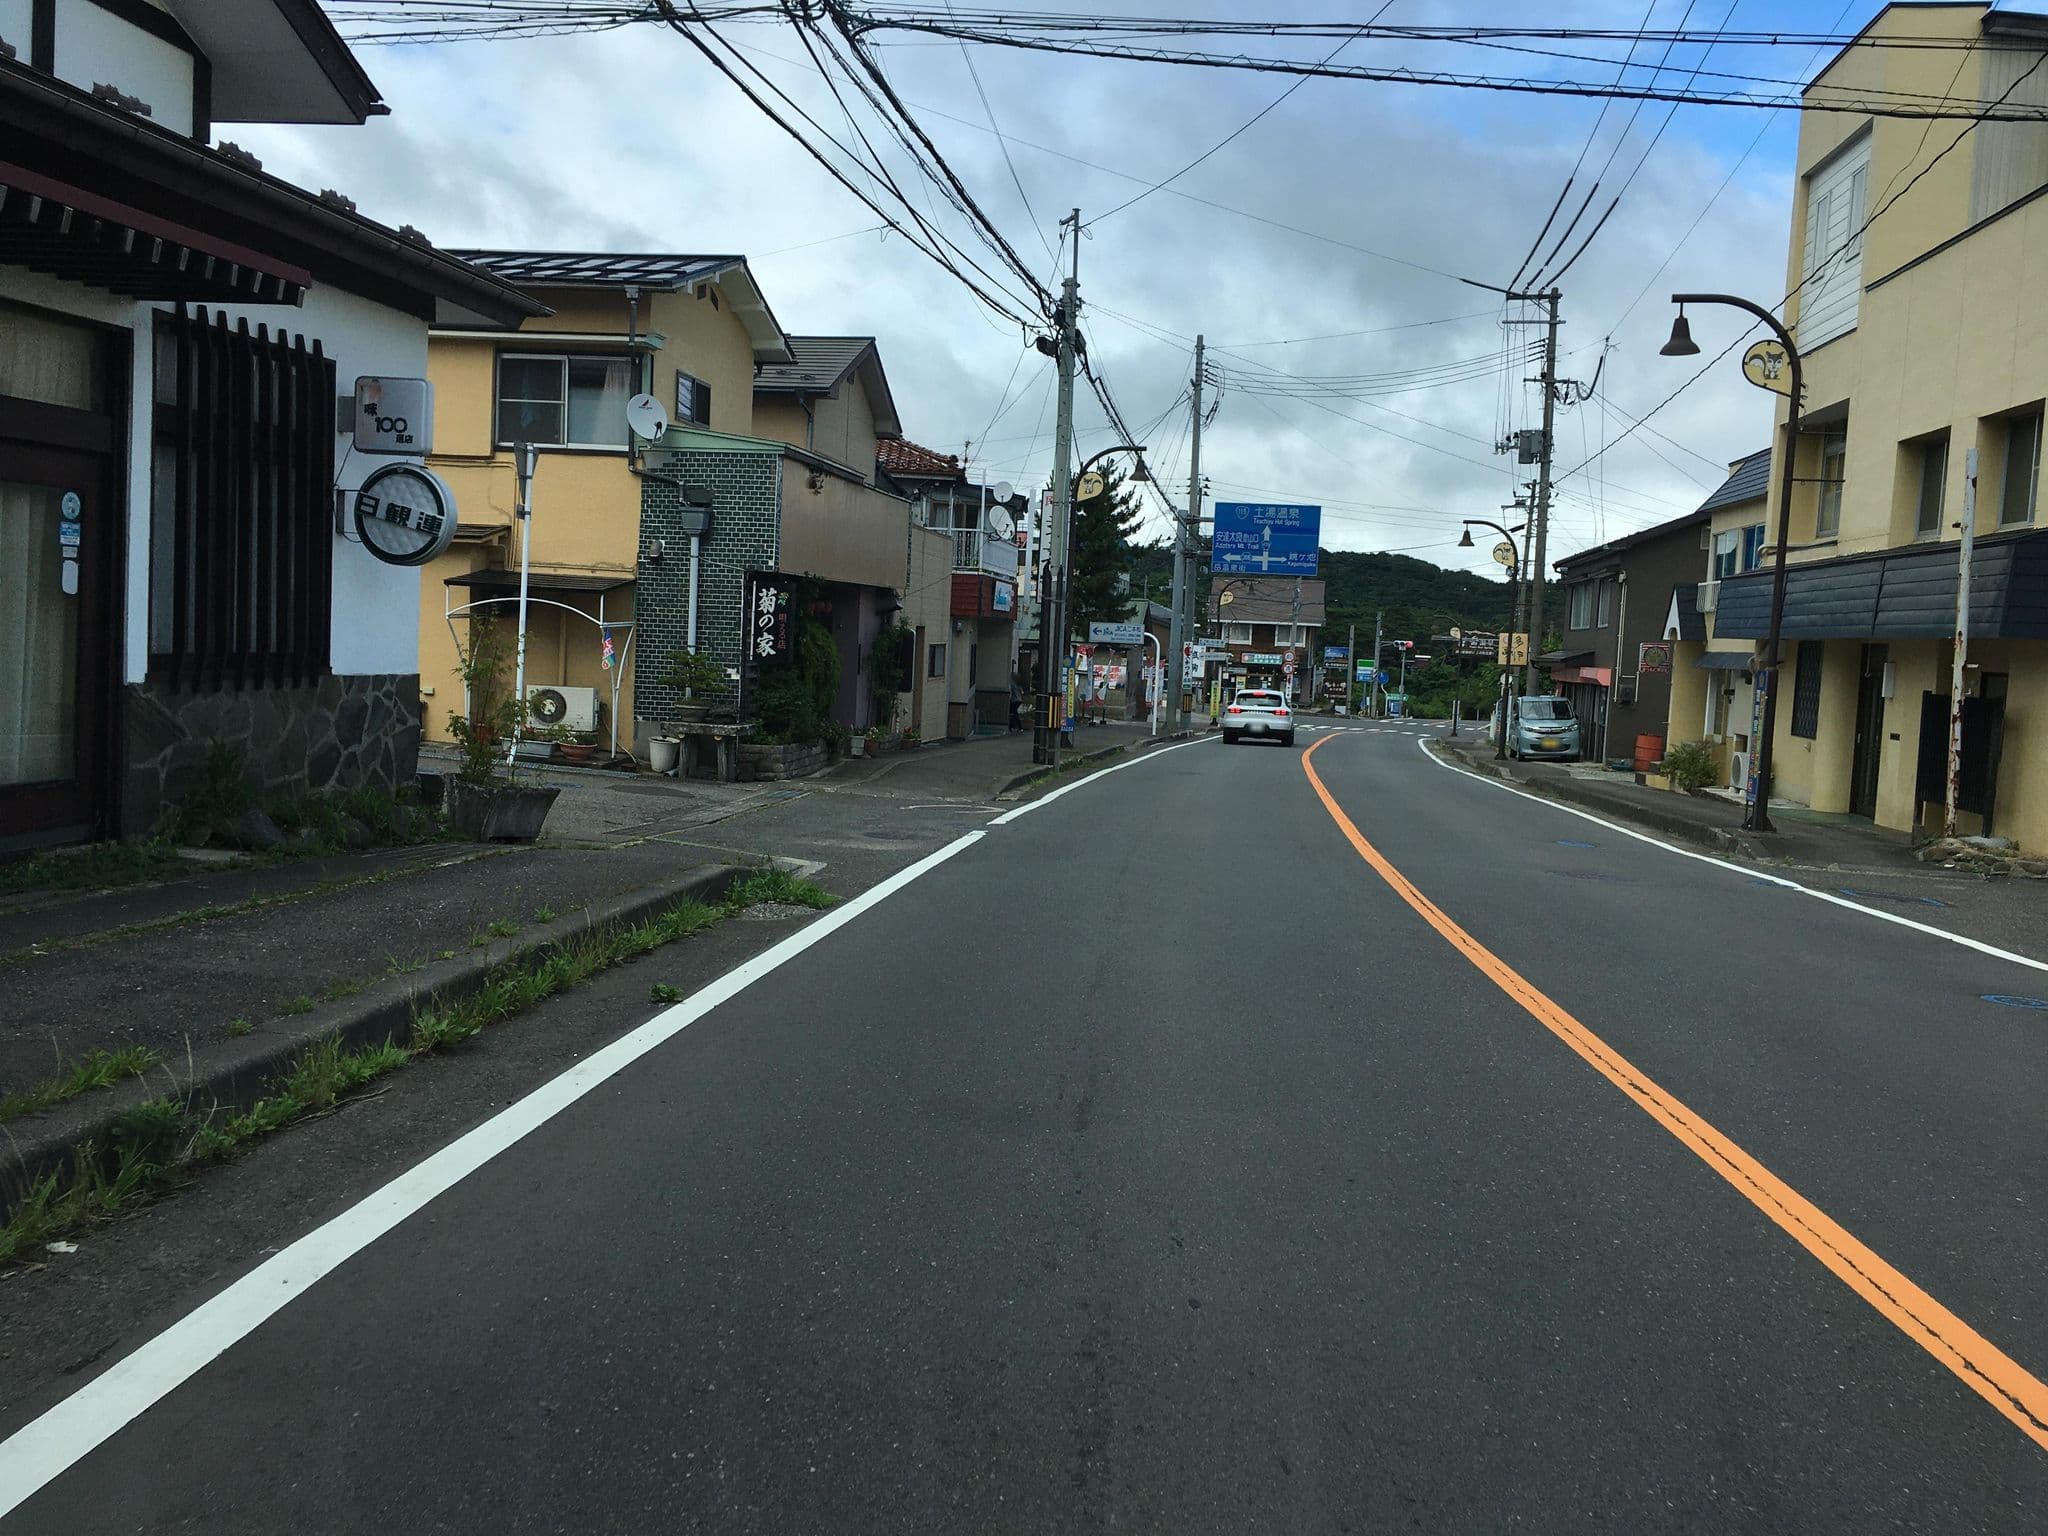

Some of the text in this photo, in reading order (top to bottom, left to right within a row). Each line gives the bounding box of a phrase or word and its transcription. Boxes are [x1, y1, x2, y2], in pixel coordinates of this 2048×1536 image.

[364, 403, 378, 416] 味
[375, 416, 408, 433] 100
[360, 494, 444, 536] 日観連
[1253, 506, 1300, 519] 土湯温泉
[755, 587, 777, 658] 菊の家
